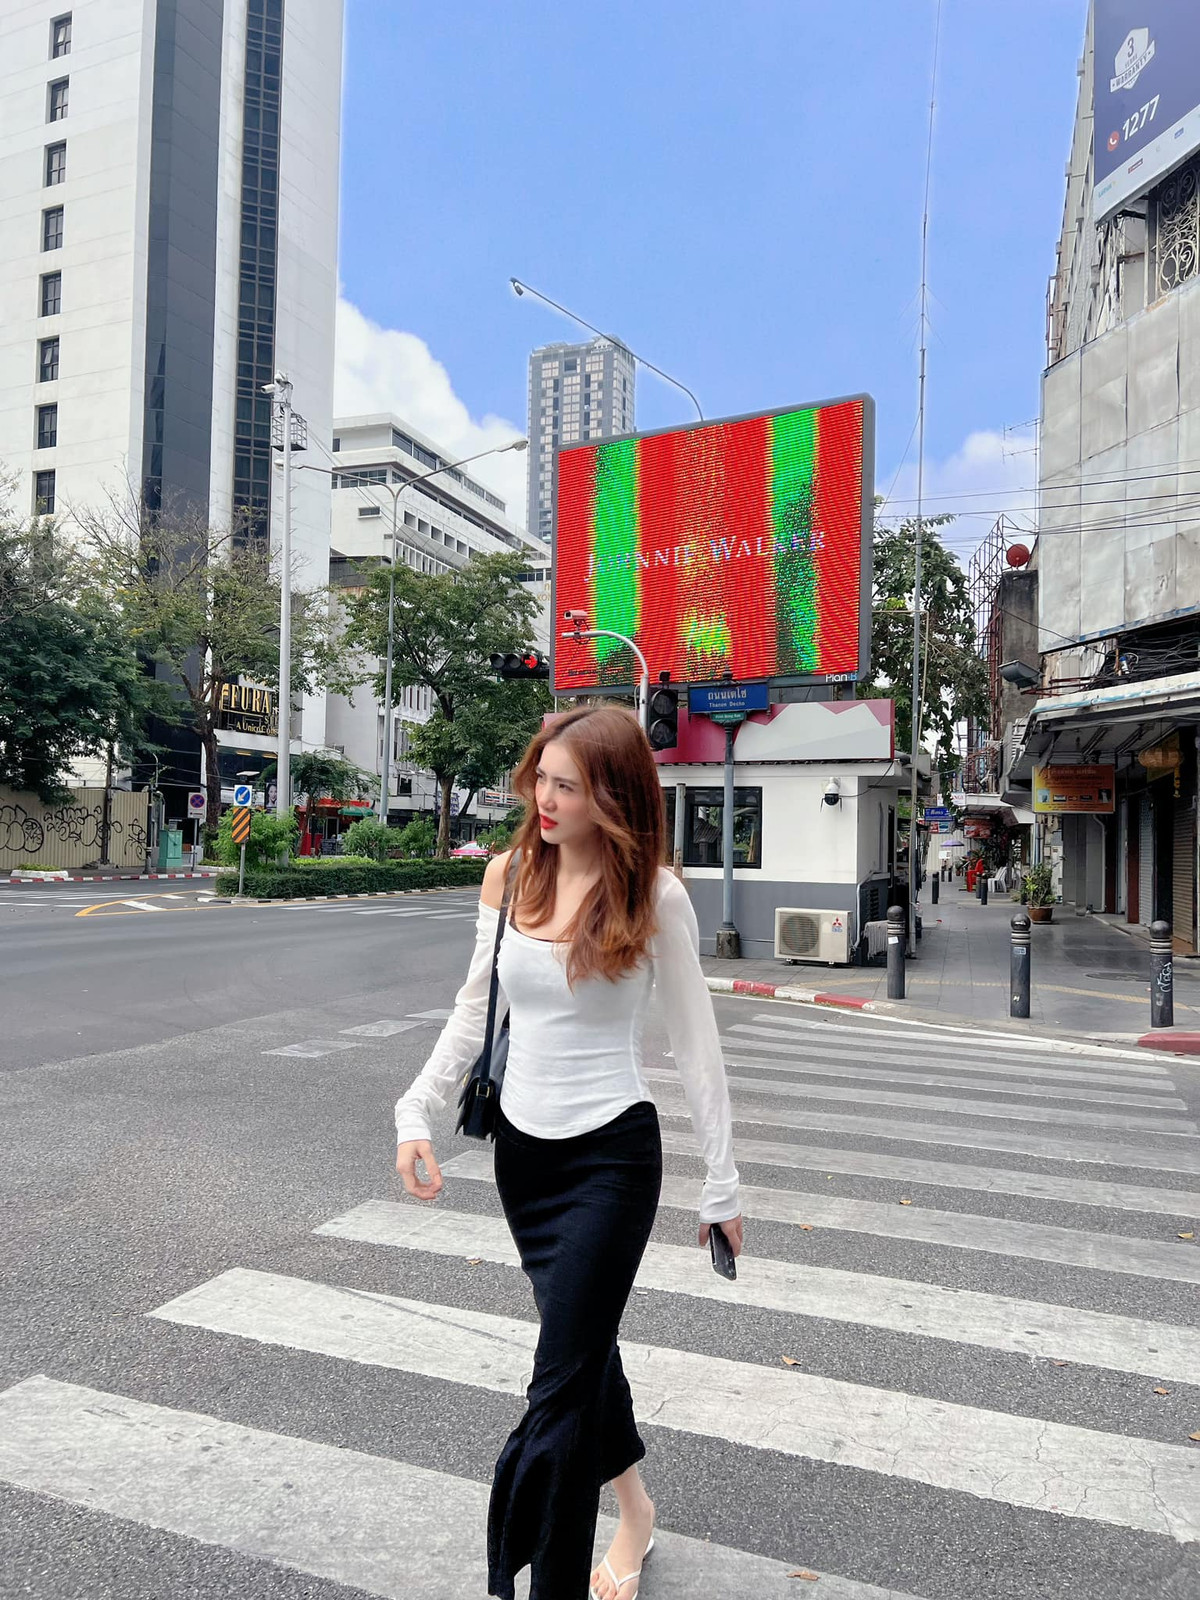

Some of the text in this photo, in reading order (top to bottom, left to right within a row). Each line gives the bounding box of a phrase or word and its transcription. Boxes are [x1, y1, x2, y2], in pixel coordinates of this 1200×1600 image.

[1127, 37, 1135, 58] 3
[1115, 53, 1148, 86] WARRANTY
[1122, 93, 1160, 142] 1277
[709, 531, 826, 562] WALKER
[231, 684, 270, 714] FURA
